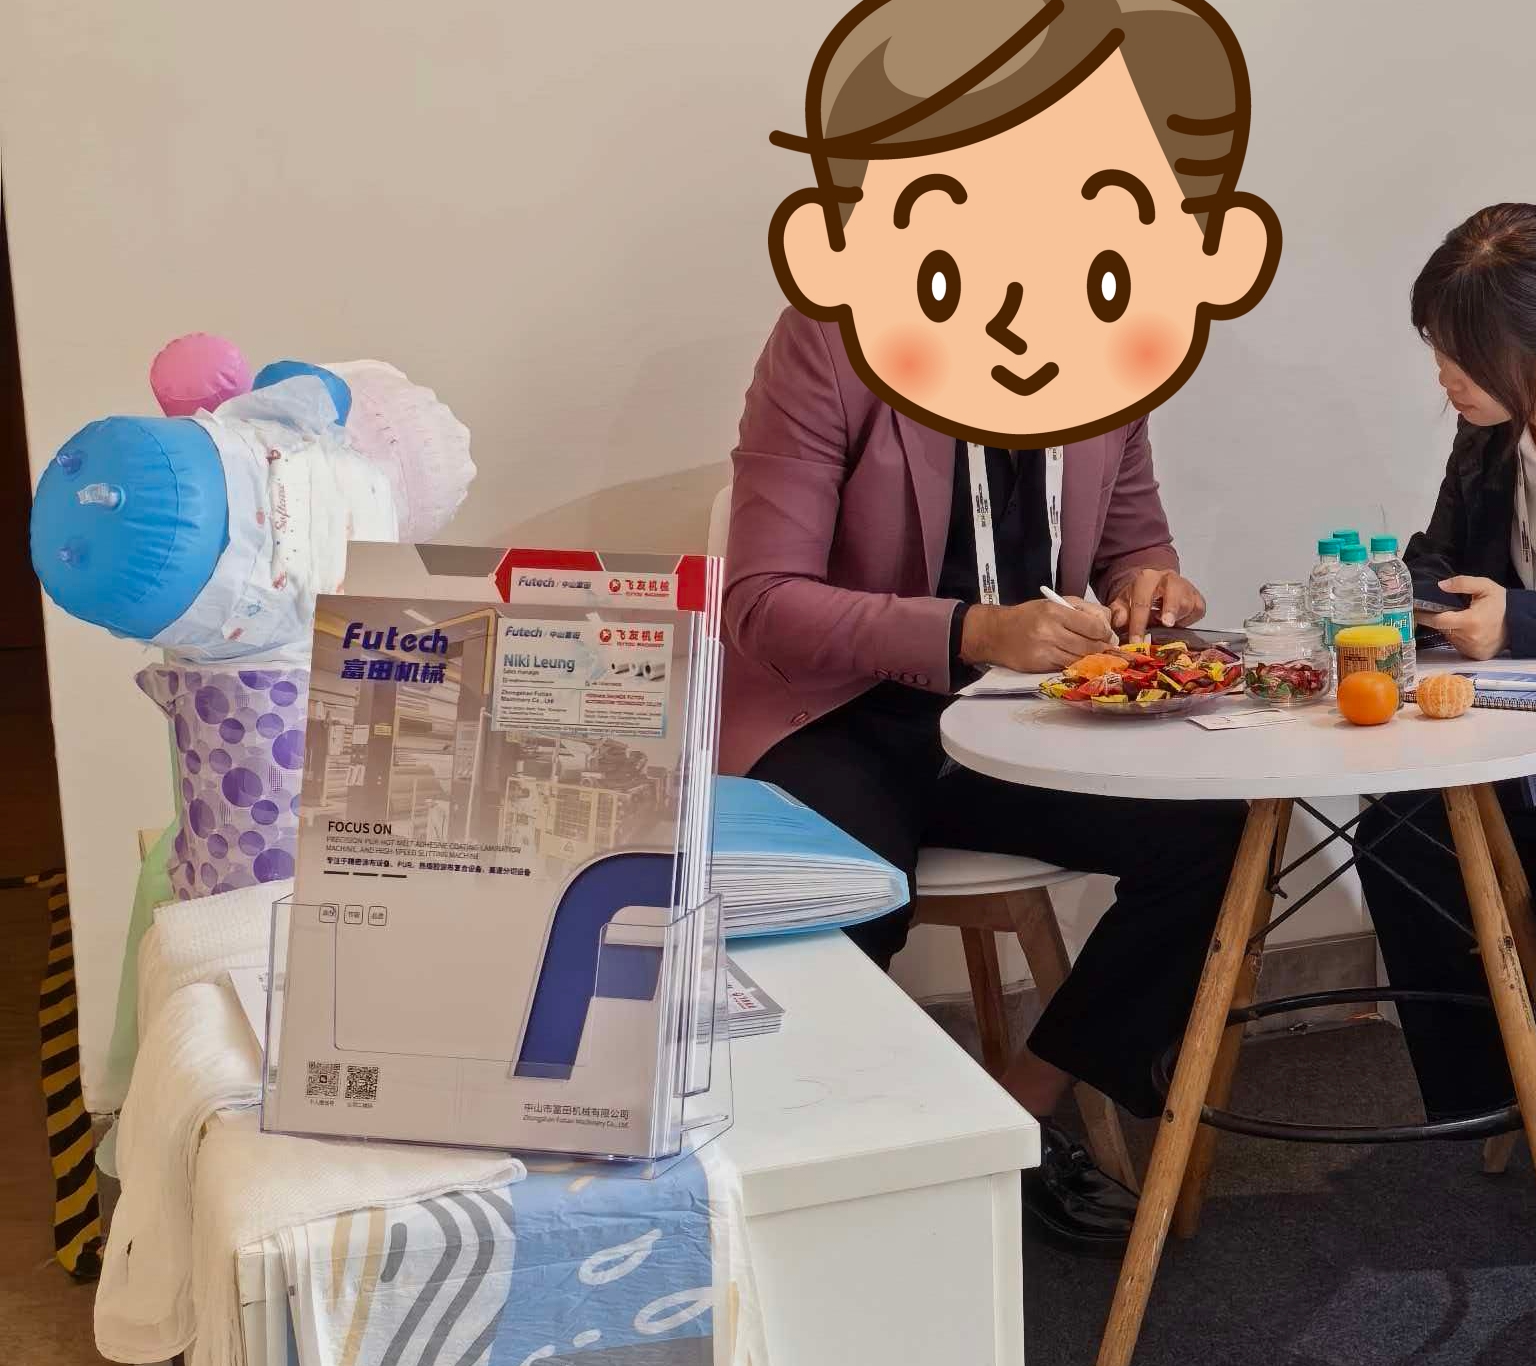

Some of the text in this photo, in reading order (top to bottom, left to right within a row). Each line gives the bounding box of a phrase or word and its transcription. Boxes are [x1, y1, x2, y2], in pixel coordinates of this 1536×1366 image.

[518, 575, 555, 589] Futech
[343, 622, 449, 654] Futech
[505, 626, 543, 639] Futech
[341, 658, 447, 684] 富田机械
[503, 653, 576, 673] Niki Leung
[327, 820, 392, 835] FOCUS ON
